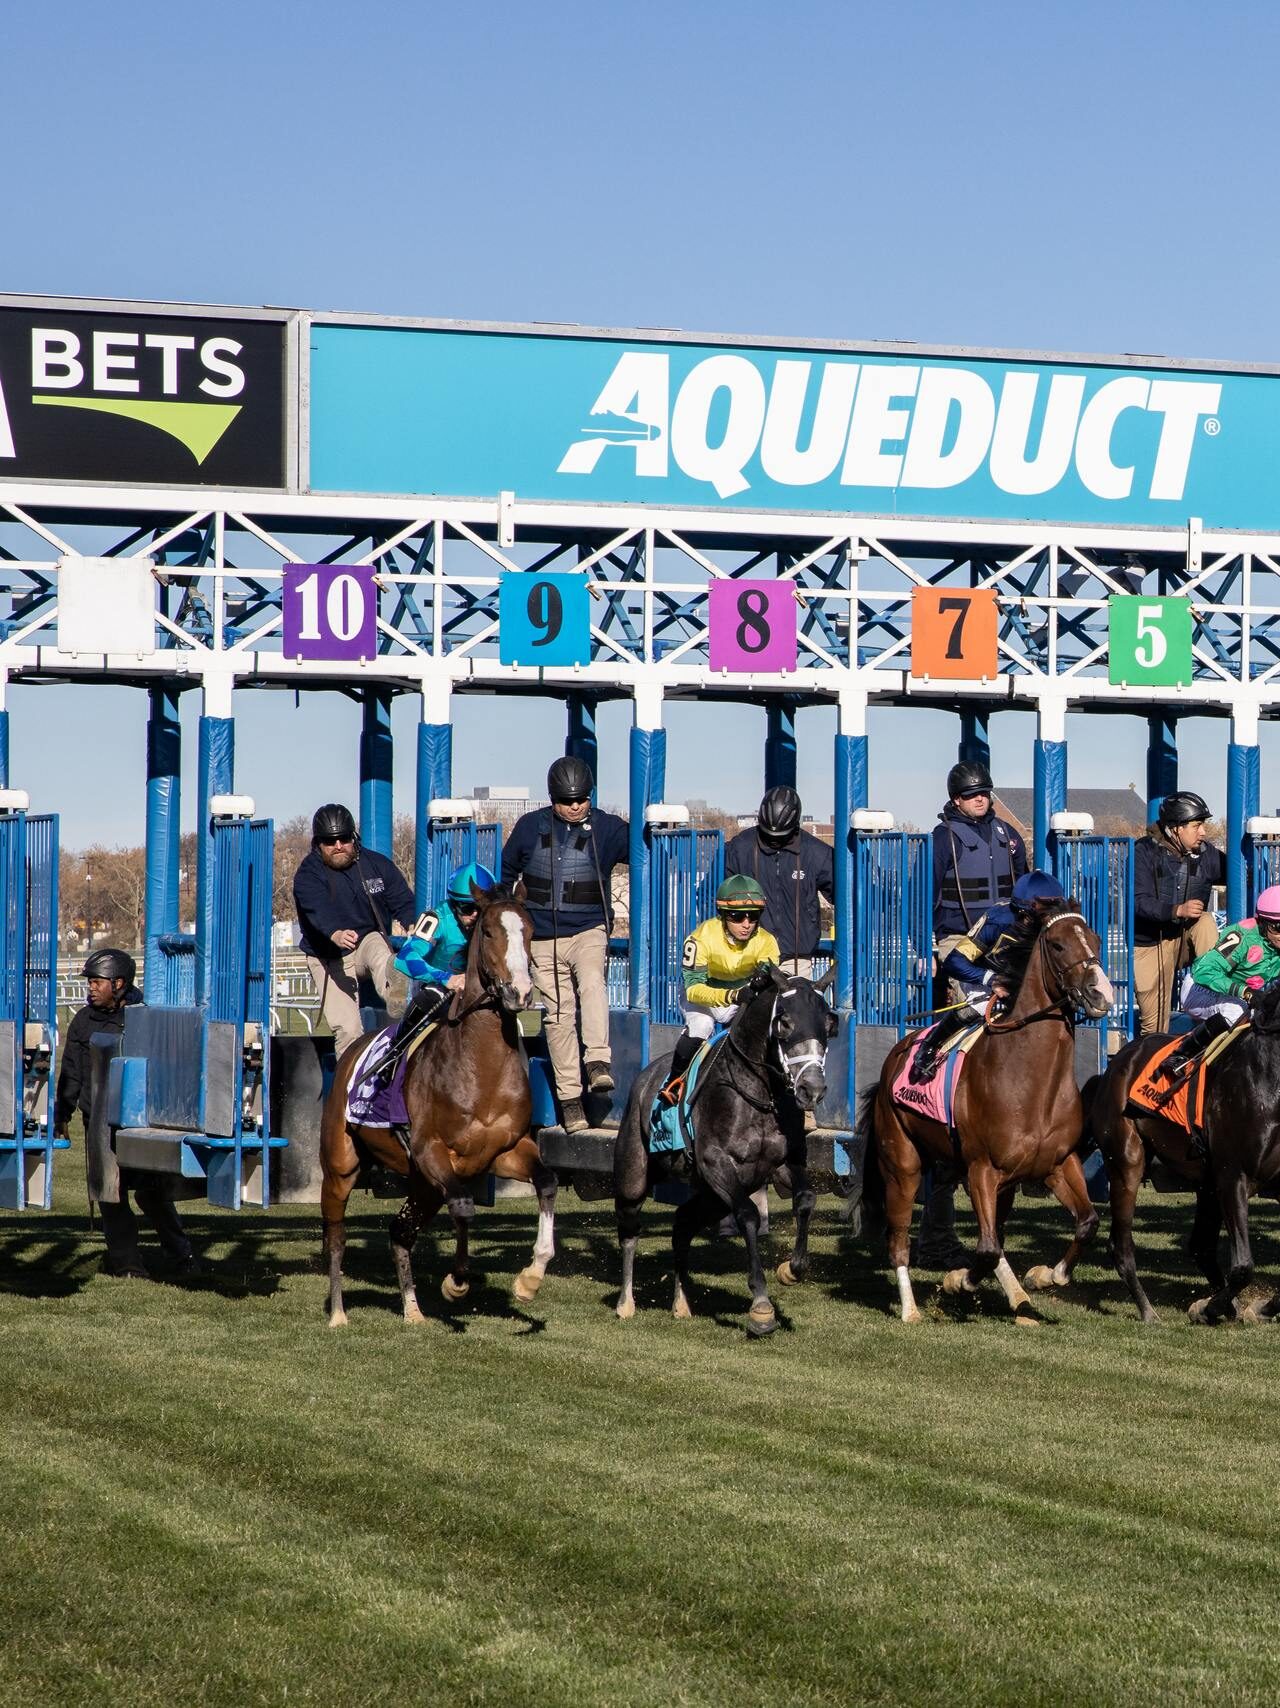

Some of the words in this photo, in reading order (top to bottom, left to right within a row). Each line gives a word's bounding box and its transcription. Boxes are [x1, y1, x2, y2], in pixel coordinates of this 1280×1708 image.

[31, 327, 246, 398] BETS
[555, 351, 1223, 499] AQUEDUCT
[294, 573, 366, 642] 10
[526, 581, 563, 647] 9
[735, 588, 771, 654] 8
[937, 597, 972, 660] 7
[1134, 604, 1167, 668] 5
[682, 940, 697, 968] 9
[1217, 933, 1240, 952] 7
